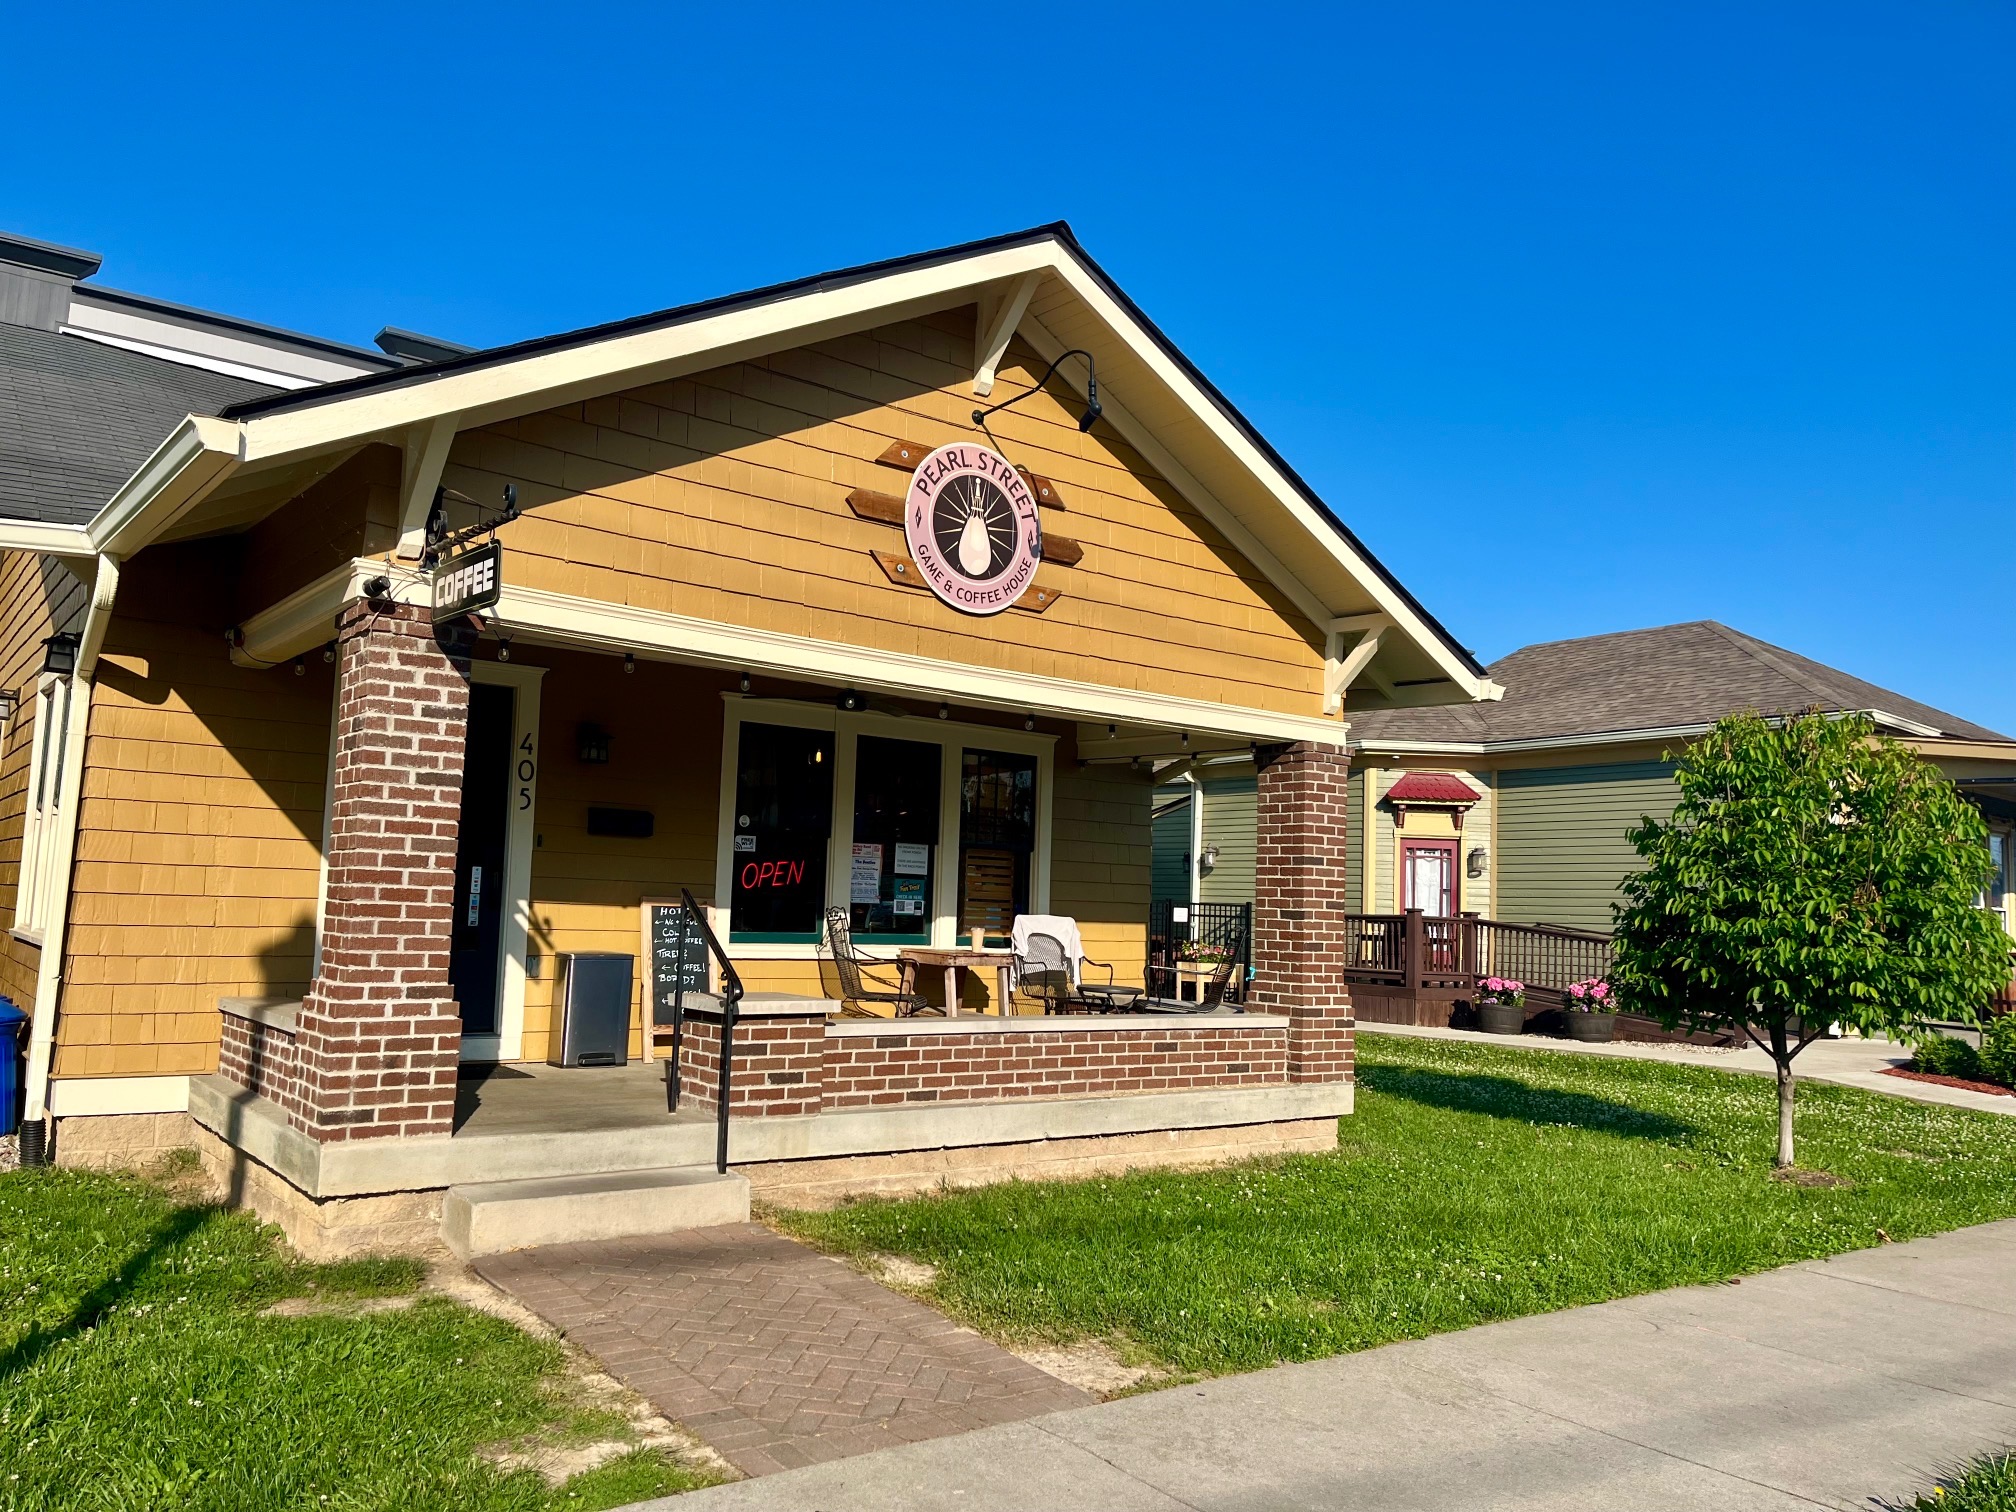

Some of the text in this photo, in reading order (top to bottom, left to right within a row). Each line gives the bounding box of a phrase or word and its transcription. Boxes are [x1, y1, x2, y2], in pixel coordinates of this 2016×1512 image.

[977, 451, 1038, 523] STREET
[435, 557, 494, 609] COFFEE
[917, 543, 1032, 604] GAME & COFFEE HOUSE
[517, 732, 535, 811] 405
[741, 860, 805, 889] OPEN
[662, 928, 690, 937] COL?
[658, 973, 695, 986] BORD?
[673, 962, 706, 973] CFFEE!
